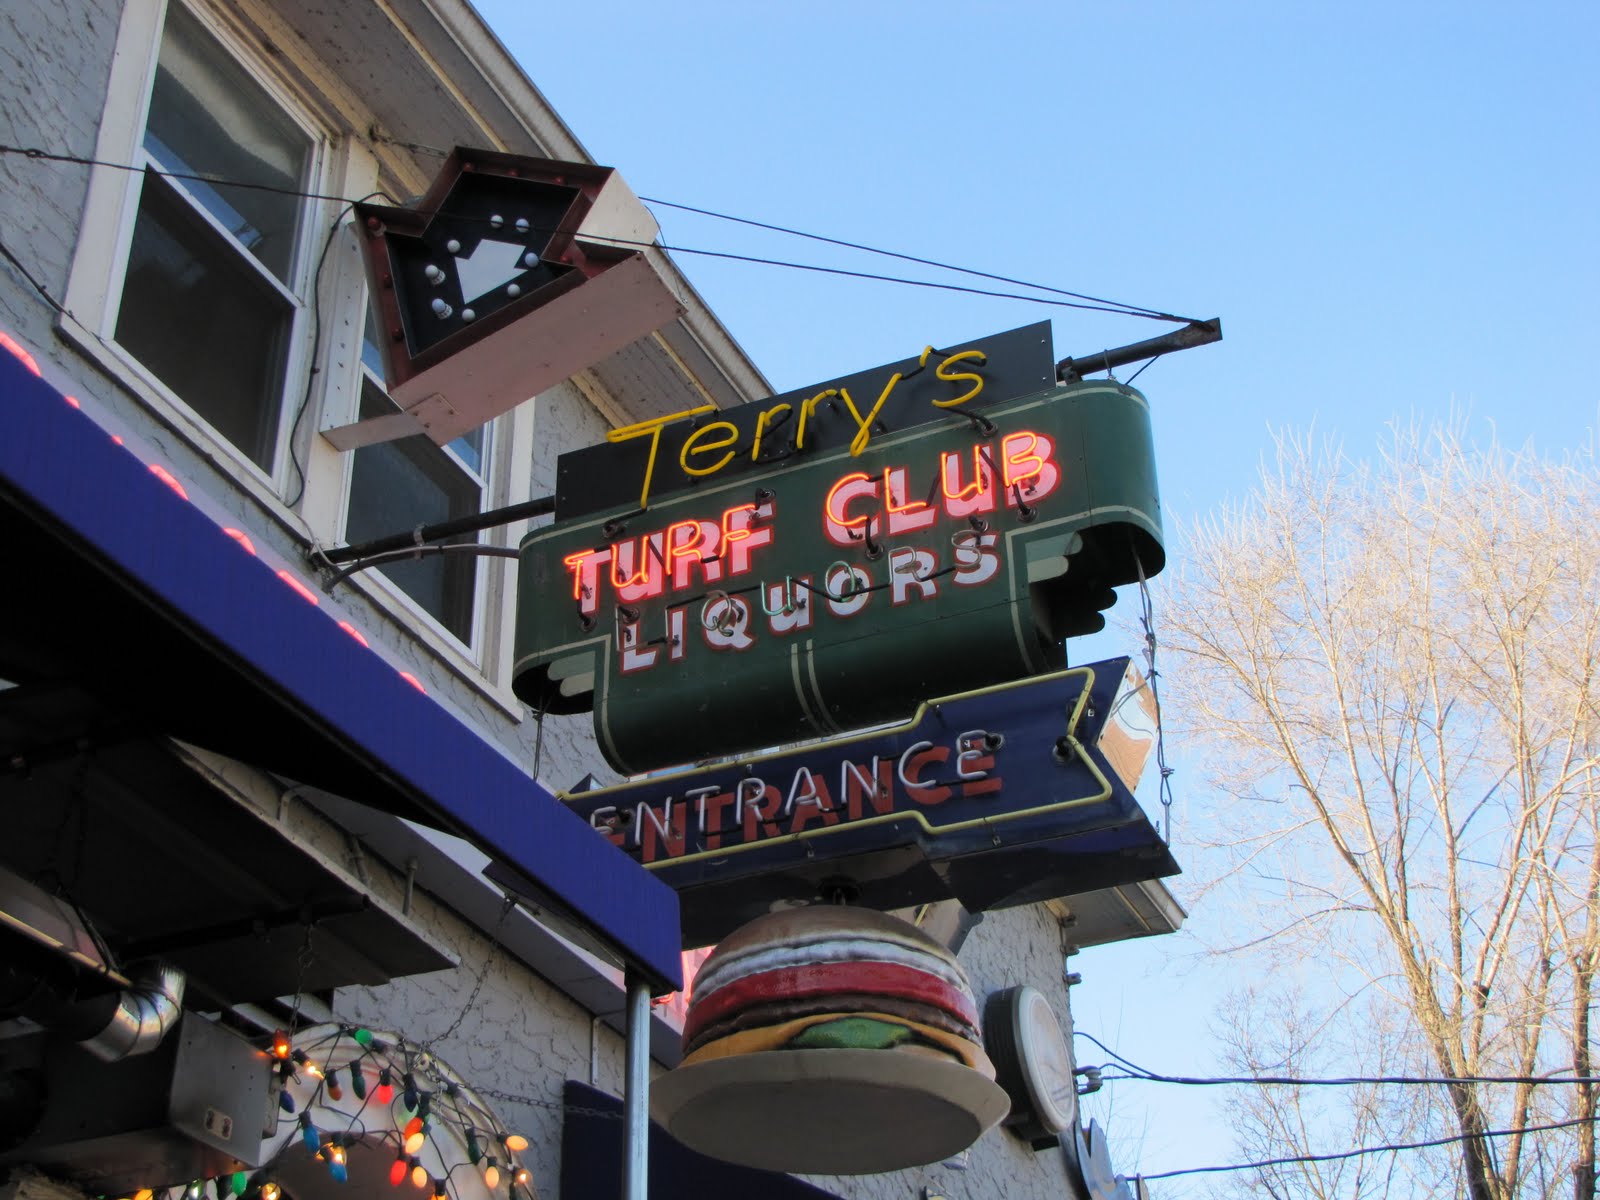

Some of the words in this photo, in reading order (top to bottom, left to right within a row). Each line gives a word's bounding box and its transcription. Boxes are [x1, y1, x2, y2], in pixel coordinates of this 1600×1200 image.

[607, 346, 987, 511] Terry's
[564, 500, 776, 613] TURF
[825, 431, 1063, 546] CLUB
[616, 530, 1000, 673] LIQUORS
